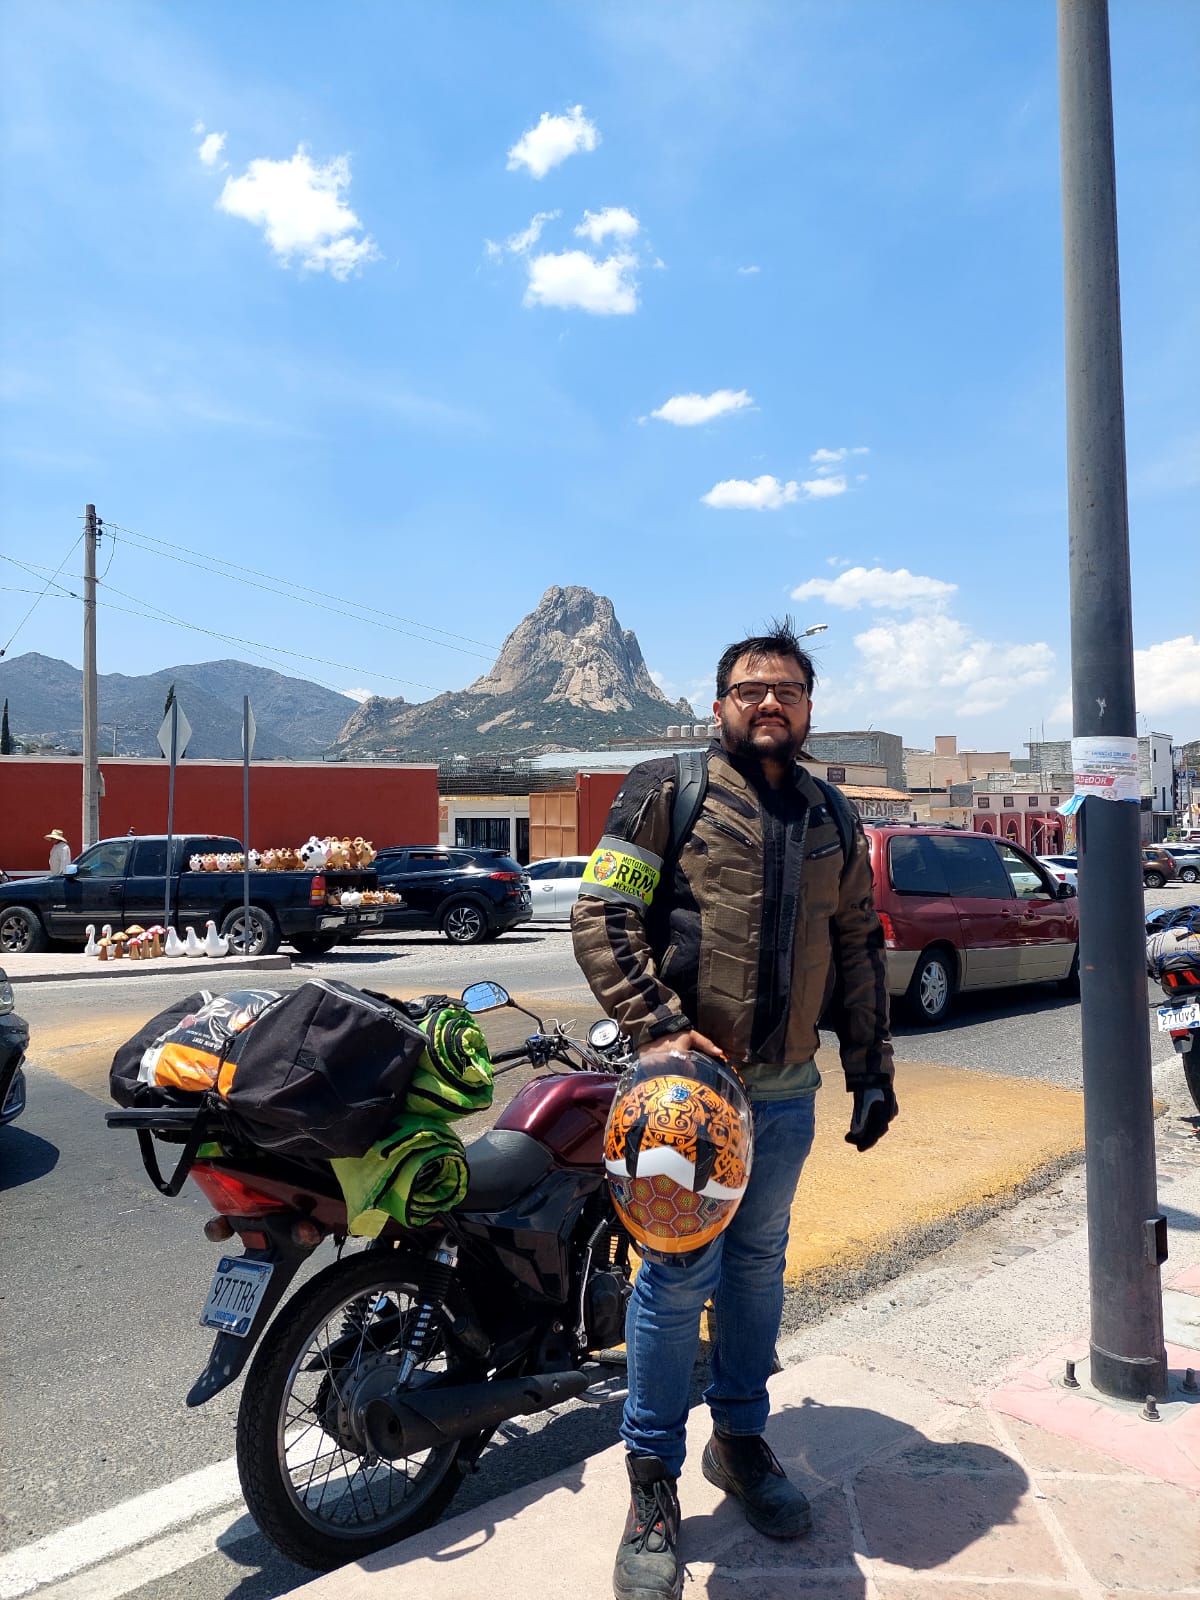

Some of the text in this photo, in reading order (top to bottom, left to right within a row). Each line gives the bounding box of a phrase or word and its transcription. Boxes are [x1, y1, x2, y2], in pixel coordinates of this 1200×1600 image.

[616, 864, 654, 893] RRM
[1162, 1010, 1196, 1025] 27TUV9
[211, 1277, 260, 1313] 97TTR6
